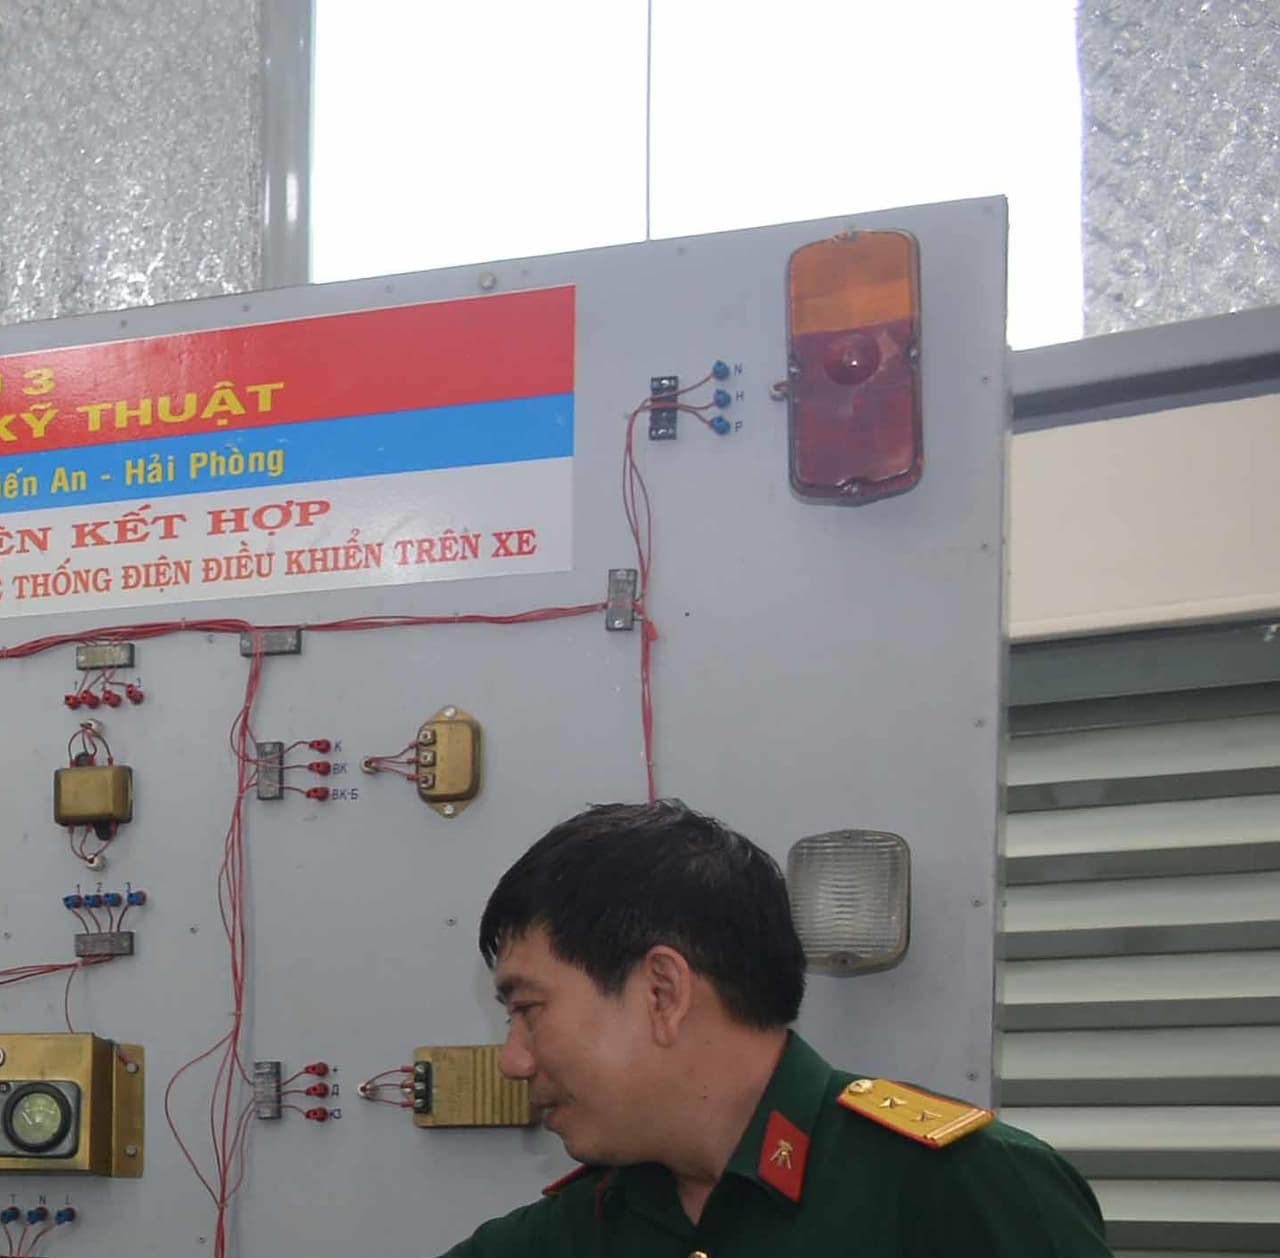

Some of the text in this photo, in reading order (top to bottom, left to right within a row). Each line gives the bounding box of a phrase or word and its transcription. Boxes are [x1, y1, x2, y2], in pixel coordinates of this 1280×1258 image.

[23, 367, 56, 394] 3
[77, 380, 284, 431] THUẬT
[51, 467, 88, 491] An
[125, 453, 176, 485] Hải
[190, 447, 285, 479] Phòng
[71, 504, 187, 548] KẾT
[207, 500, 331, 536] HỢP
[12, 557, 113, 598] THỐNG
[122, 556, 193, 593] ĐIỆN
[201, 541, 275, 582] ĐIỀU
[284, 528, 384, 576] KHIỂN
[391, 529, 481, 565] TRÊN
[490, 529, 538, 558] XE
